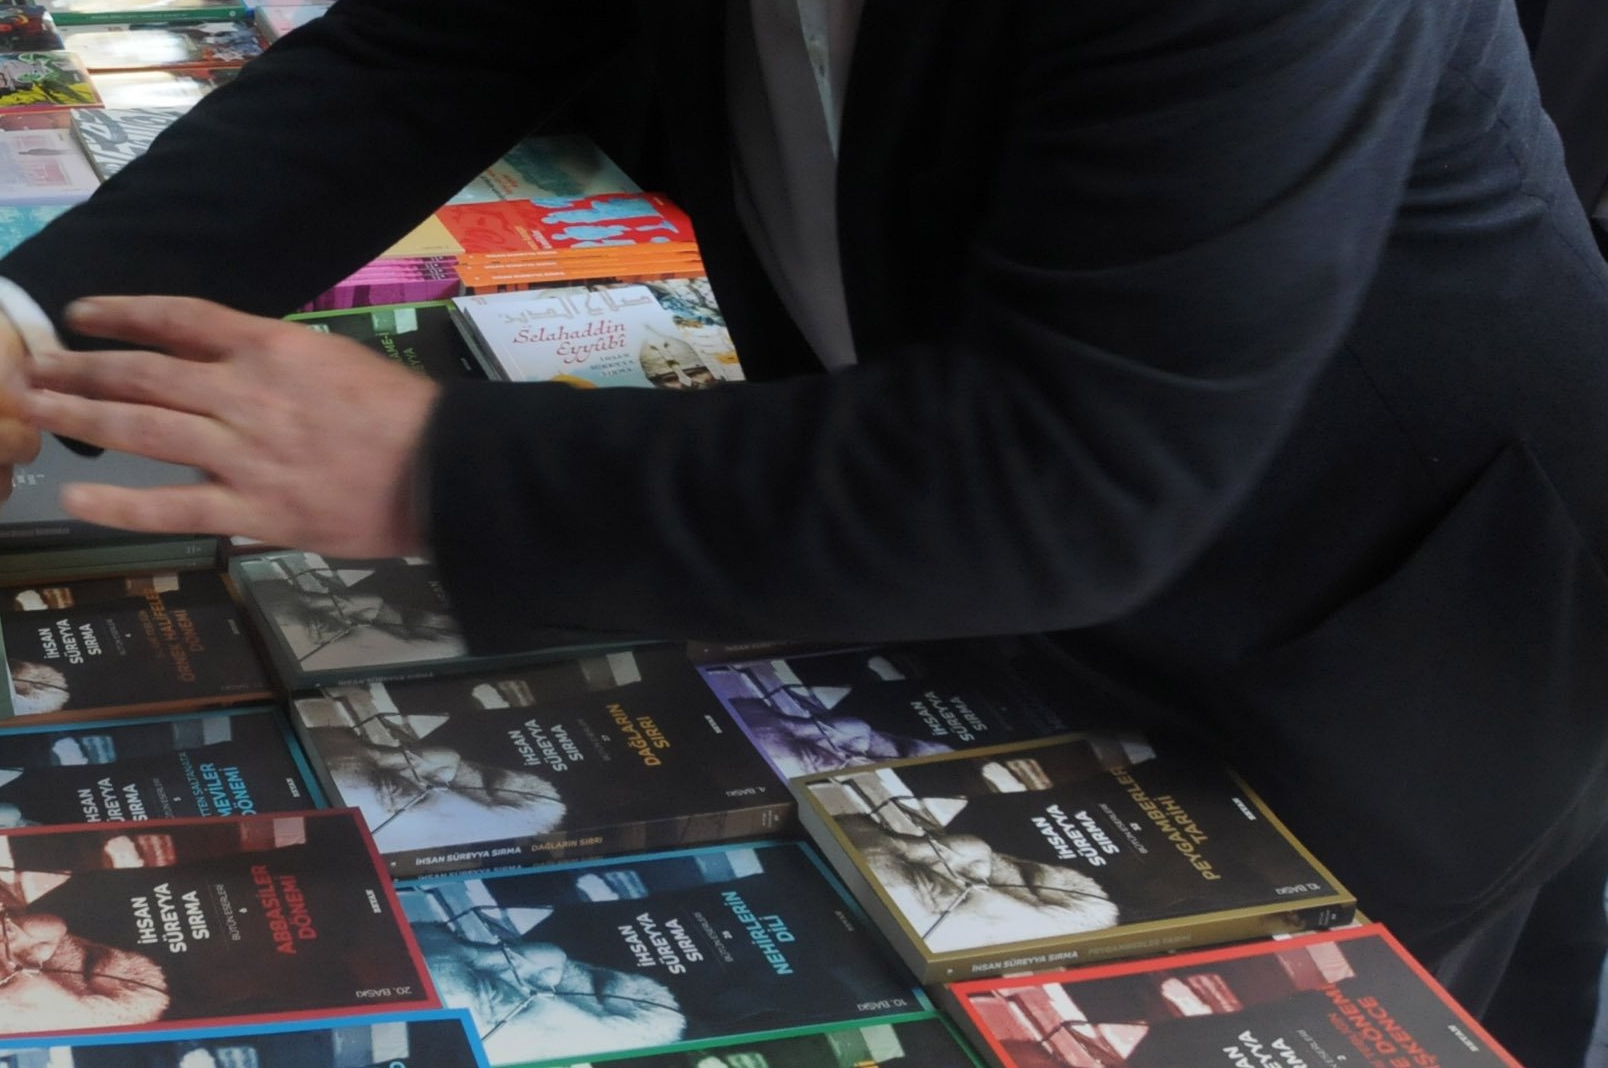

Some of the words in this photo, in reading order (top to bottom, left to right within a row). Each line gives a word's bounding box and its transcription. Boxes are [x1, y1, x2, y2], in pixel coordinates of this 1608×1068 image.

[512, 319, 627, 344] Selahaddin
[38, 627, 60, 659] İHSAN
[56, 618, 83, 664] SÜREYYA
[78, 623, 102, 656] SIRMA
[636, 715, 671, 750] SIRRI
[911, 701, 949, 736] İHSAN
[924, 690, 975, 742] SÜREYYA
[949, 695, 989, 731] SIRMA
[507, 730, 541, 767] İHSAN
[523, 718, 568, 773] SÜREYYA
[551, 723, 584, 763] SIRMA
[606, 703, 662, 768] DAĞLARIN
[77, 788, 100, 823] HSAN
[97, 777, 125, 823] ÜREYYA
[122, 783, 148, 822] SIRMA
[200, 762, 231, 817] MEVİLER
[1031, 816, 1076, 860] İHSAN
[1046, 804, 1107, 867] SÜREYYA
[1071, 809, 1120, 854] SIRMA
[1107, 766, 1221, 881] PEYGAMBERLER
[1154, 795, 1209, 842] TARİHİ
[415, 855, 446, 866] İHSAN
[447, 850, 490, 863] SÜREYYA
[491, 845, 522, 857] SIRMA
[130, 896, 158, 945] İHSAN
[153, 882, 188, 954] SÜREYYA
[181, 889, 210, 940] SIRMA
[251, 864, 297, 955] ABBASİLER
[278, 874, 318, 940] DÖNEMİ
[758, 914, 795, 943] DİLİ
[618, 924, 657, 967] İHSAN
[636, 912, 686, 975] SÜREYYA
[664, 918, 704, 962] SIRMA
[721, 890, 795, 976] NEHİRLERİN
[972, 960, 1003, 973] İHSAN
[1003, 955, 1048, 969] SÜREYYA
[1048, 950, 1079, 963] SIRMA
[355, 988, 392, 998] BASKI
